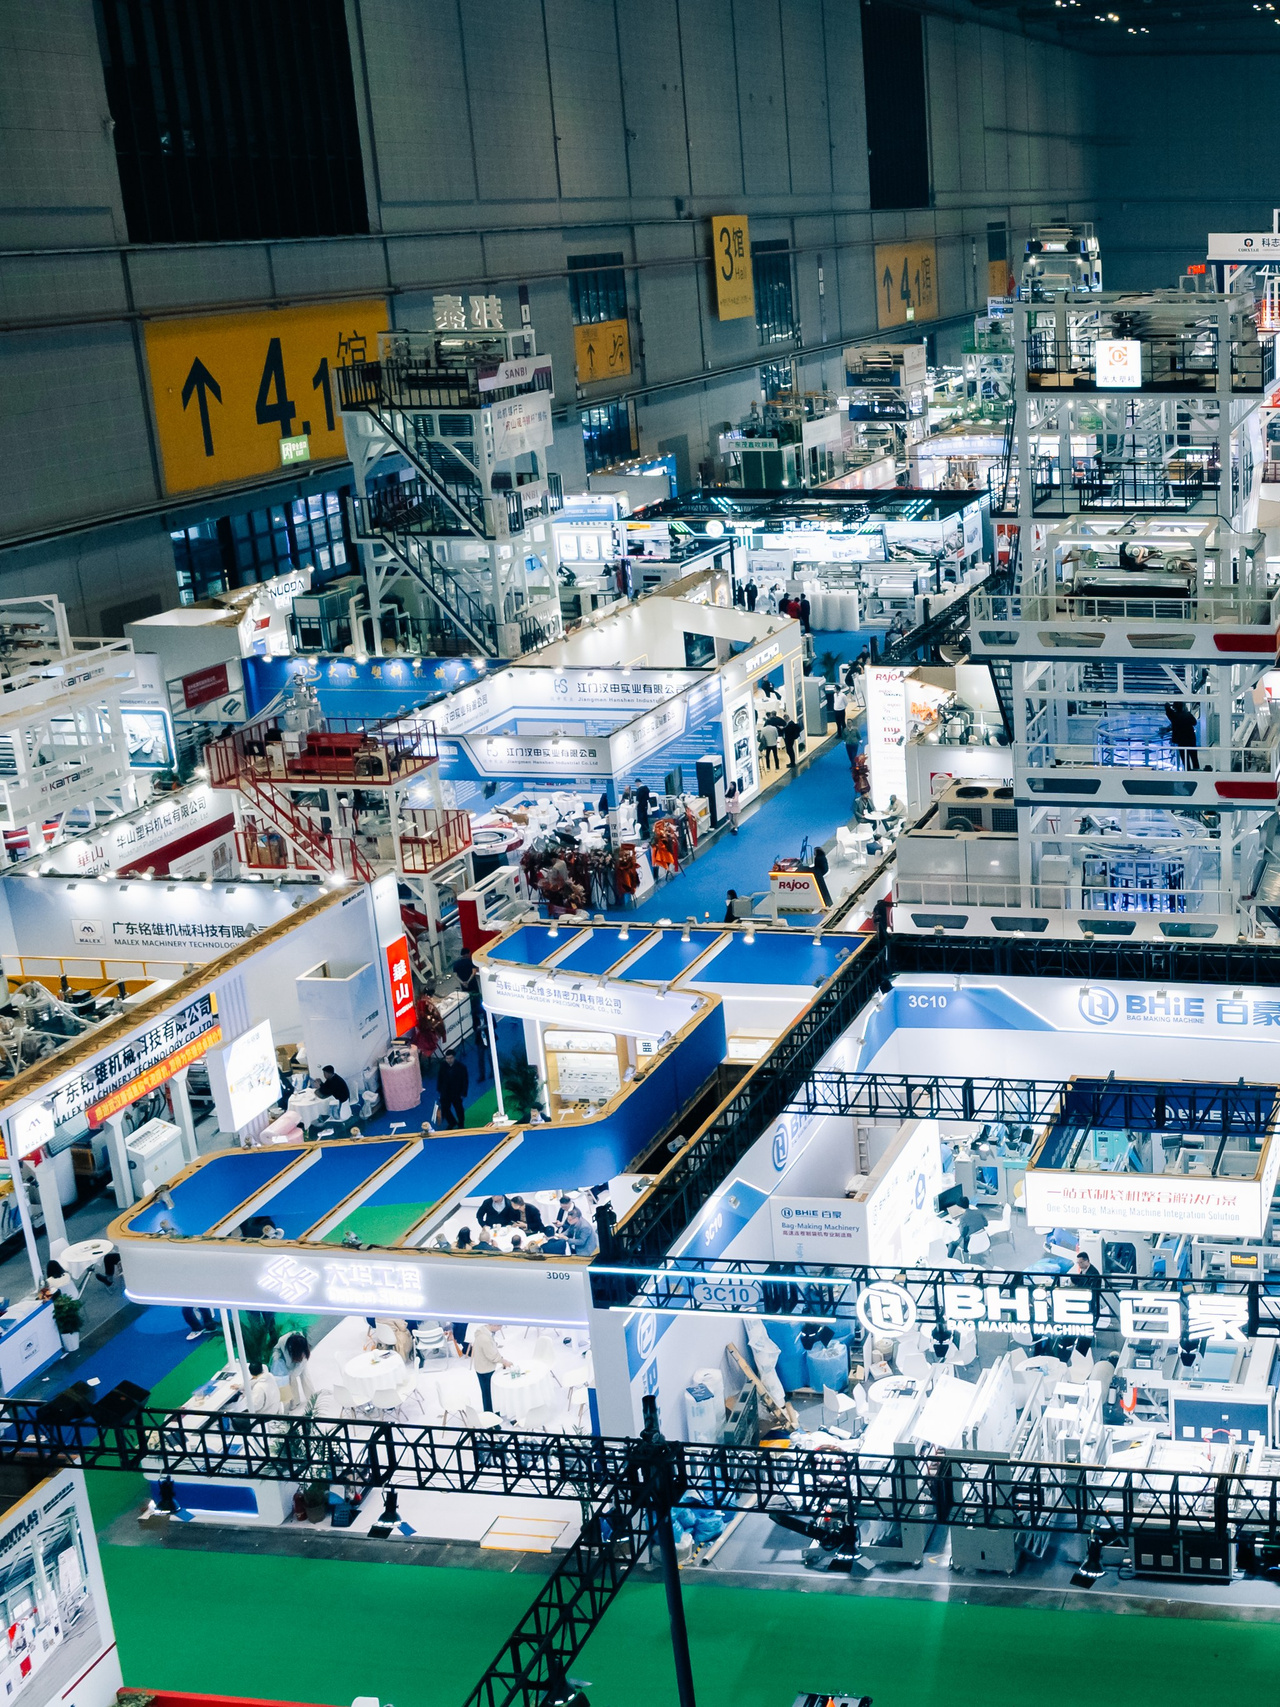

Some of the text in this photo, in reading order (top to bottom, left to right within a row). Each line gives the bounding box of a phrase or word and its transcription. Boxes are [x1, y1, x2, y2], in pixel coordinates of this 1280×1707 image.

[504, 367, 528, 380] SANBI
[908, 995, 948, 1009] 3C10
[1172, 1017, 1205, 1025] MACHINE
[84, 1073, 132, 1107] MACHINERY
[133, 1043, 183, 1077] TECHNOLOGY
[1046, 1203, 1240, 1221] One Stop Bag Making Machine Integration Solution
[705, 1212, 722, 1247] 3C10
[824, 1224, 860, 1232] Machinery
[546, 1271, 570, 1280] 3D09
[702, 1286, 749, 1303] 3C10
[947, 1320, 1095, 1337] BAG MAKING MACHINE
